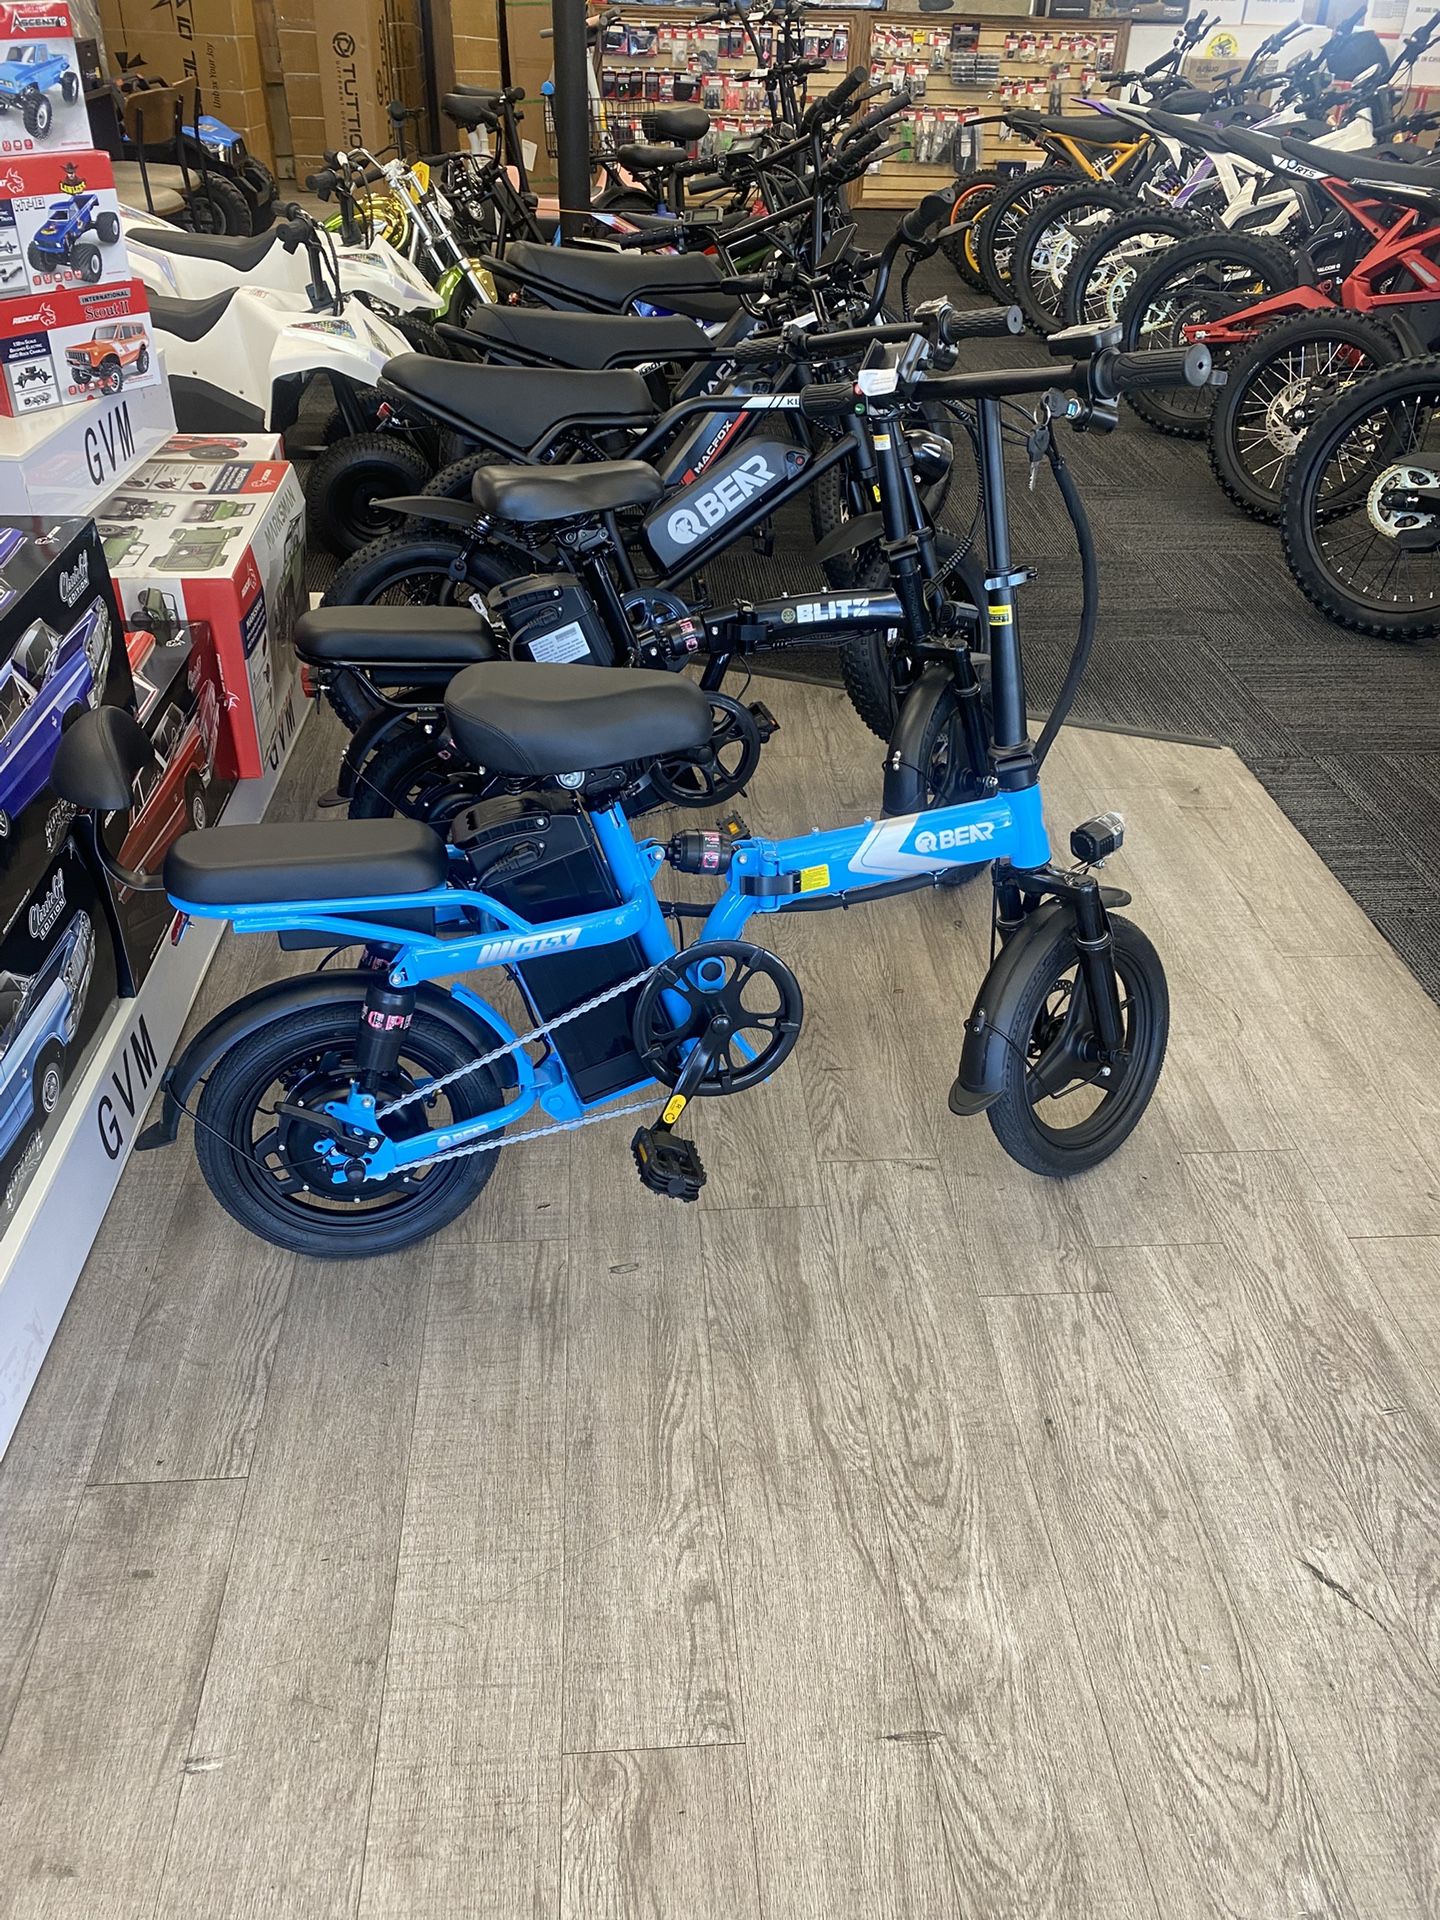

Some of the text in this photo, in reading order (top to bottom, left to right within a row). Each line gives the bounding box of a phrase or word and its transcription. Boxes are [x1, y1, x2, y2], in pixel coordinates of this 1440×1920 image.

[10, 9, 58, 33] ASCENT
[205, 42, 216, 58] Joy
[207, 57, 217, 80] Your
[81, 291, 129, 303] INTERNATIONAL
[12, 313, 41, 325] REDCAT
[84, 304, 119, 320] Scout
[85, 400, 136, 486] GVM
[693, 419, 733, 474] MACFOX
[796, 597, 870, 624] BLITZ
[40, 897, 67, 940] EDITION
[97, 1013, 158, 1160] GVM
